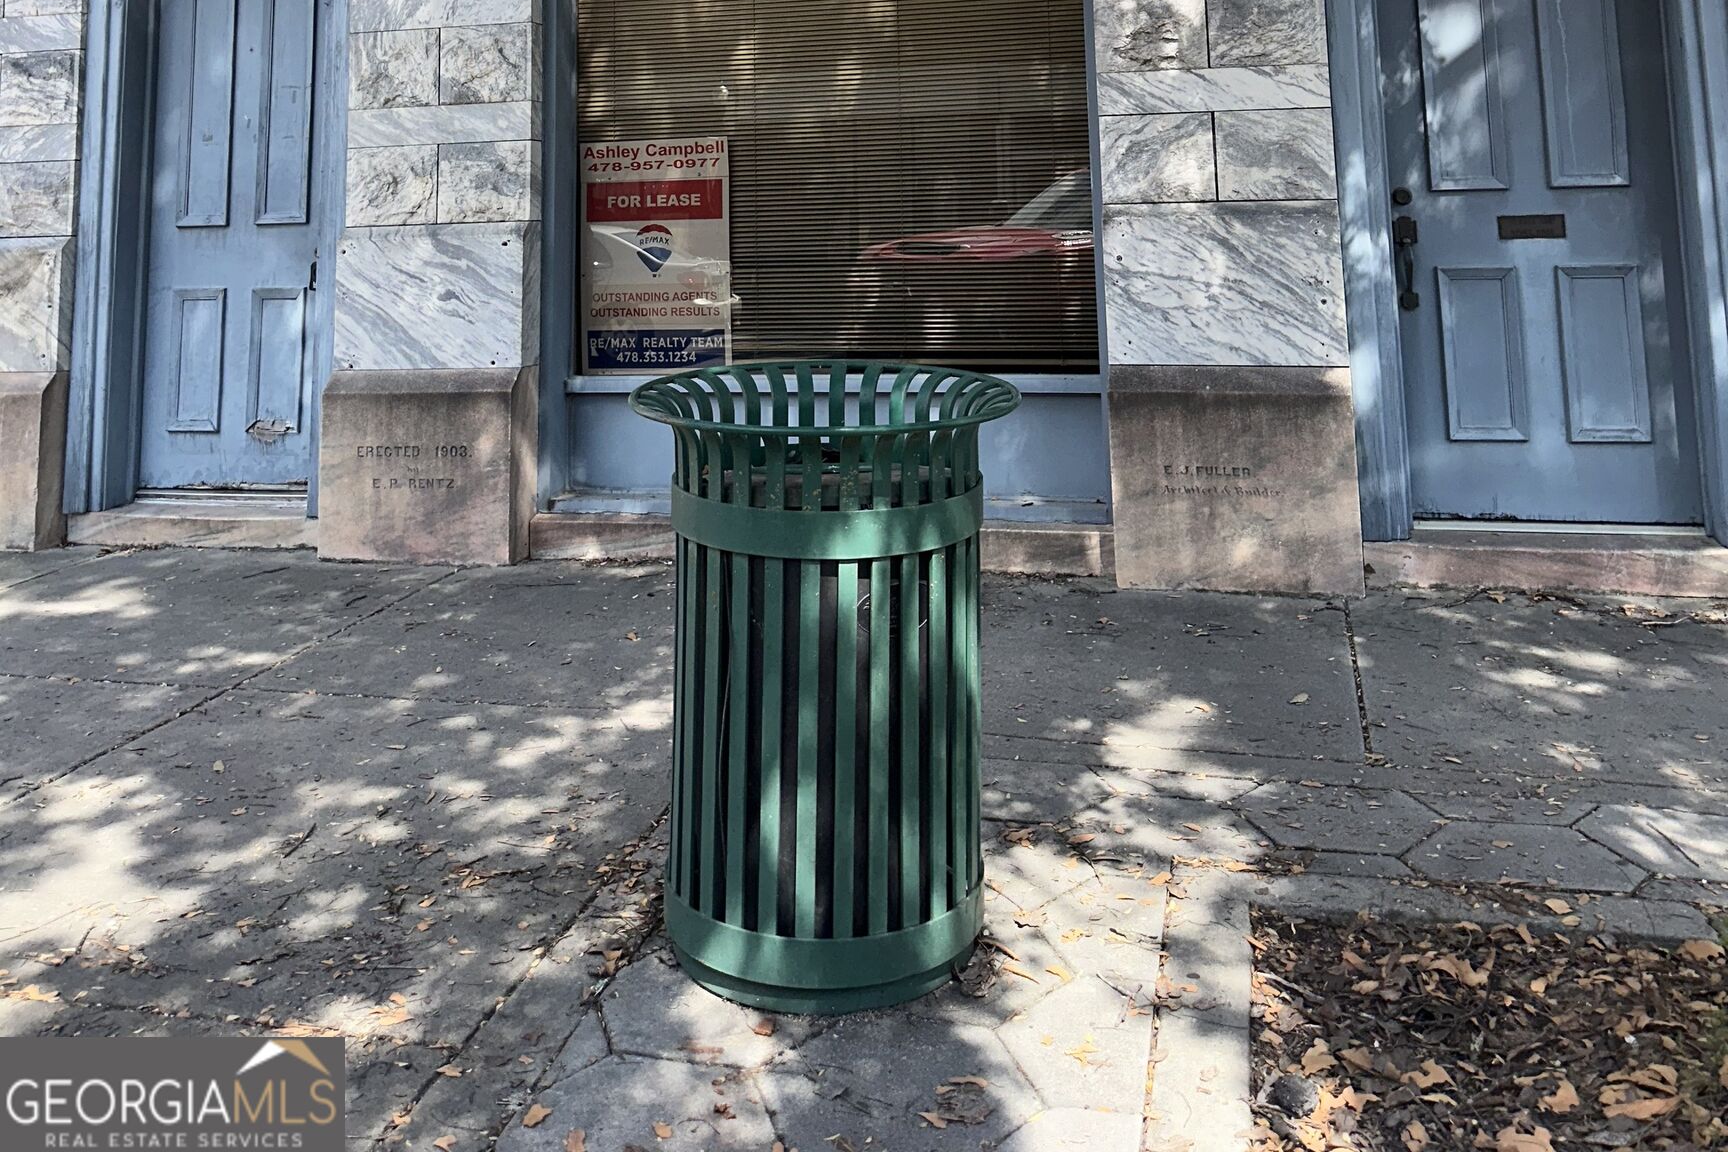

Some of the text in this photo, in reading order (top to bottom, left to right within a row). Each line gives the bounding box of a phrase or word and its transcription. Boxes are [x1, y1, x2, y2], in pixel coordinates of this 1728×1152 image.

[584, 140, 725, 160] Ashley Campbell
[587, 157, 721, 172] 478-957-0977
[607, 193, 701, 209] FOR LEASE
[640, 236, 670, 246] RE/MAX
[592, 291, 718, 303] OUTSTANDING AGENTS
[590, 306, 720, 318] OUTSTANDING RESULTS
[590, 336, 723, 349] RE/MAX REALTY TEAM
[616, 351, 697, 363] 478.353.1234
[357, 446, 420, 458] ERECTED
[408, 478, 455, 489] RENTZ
